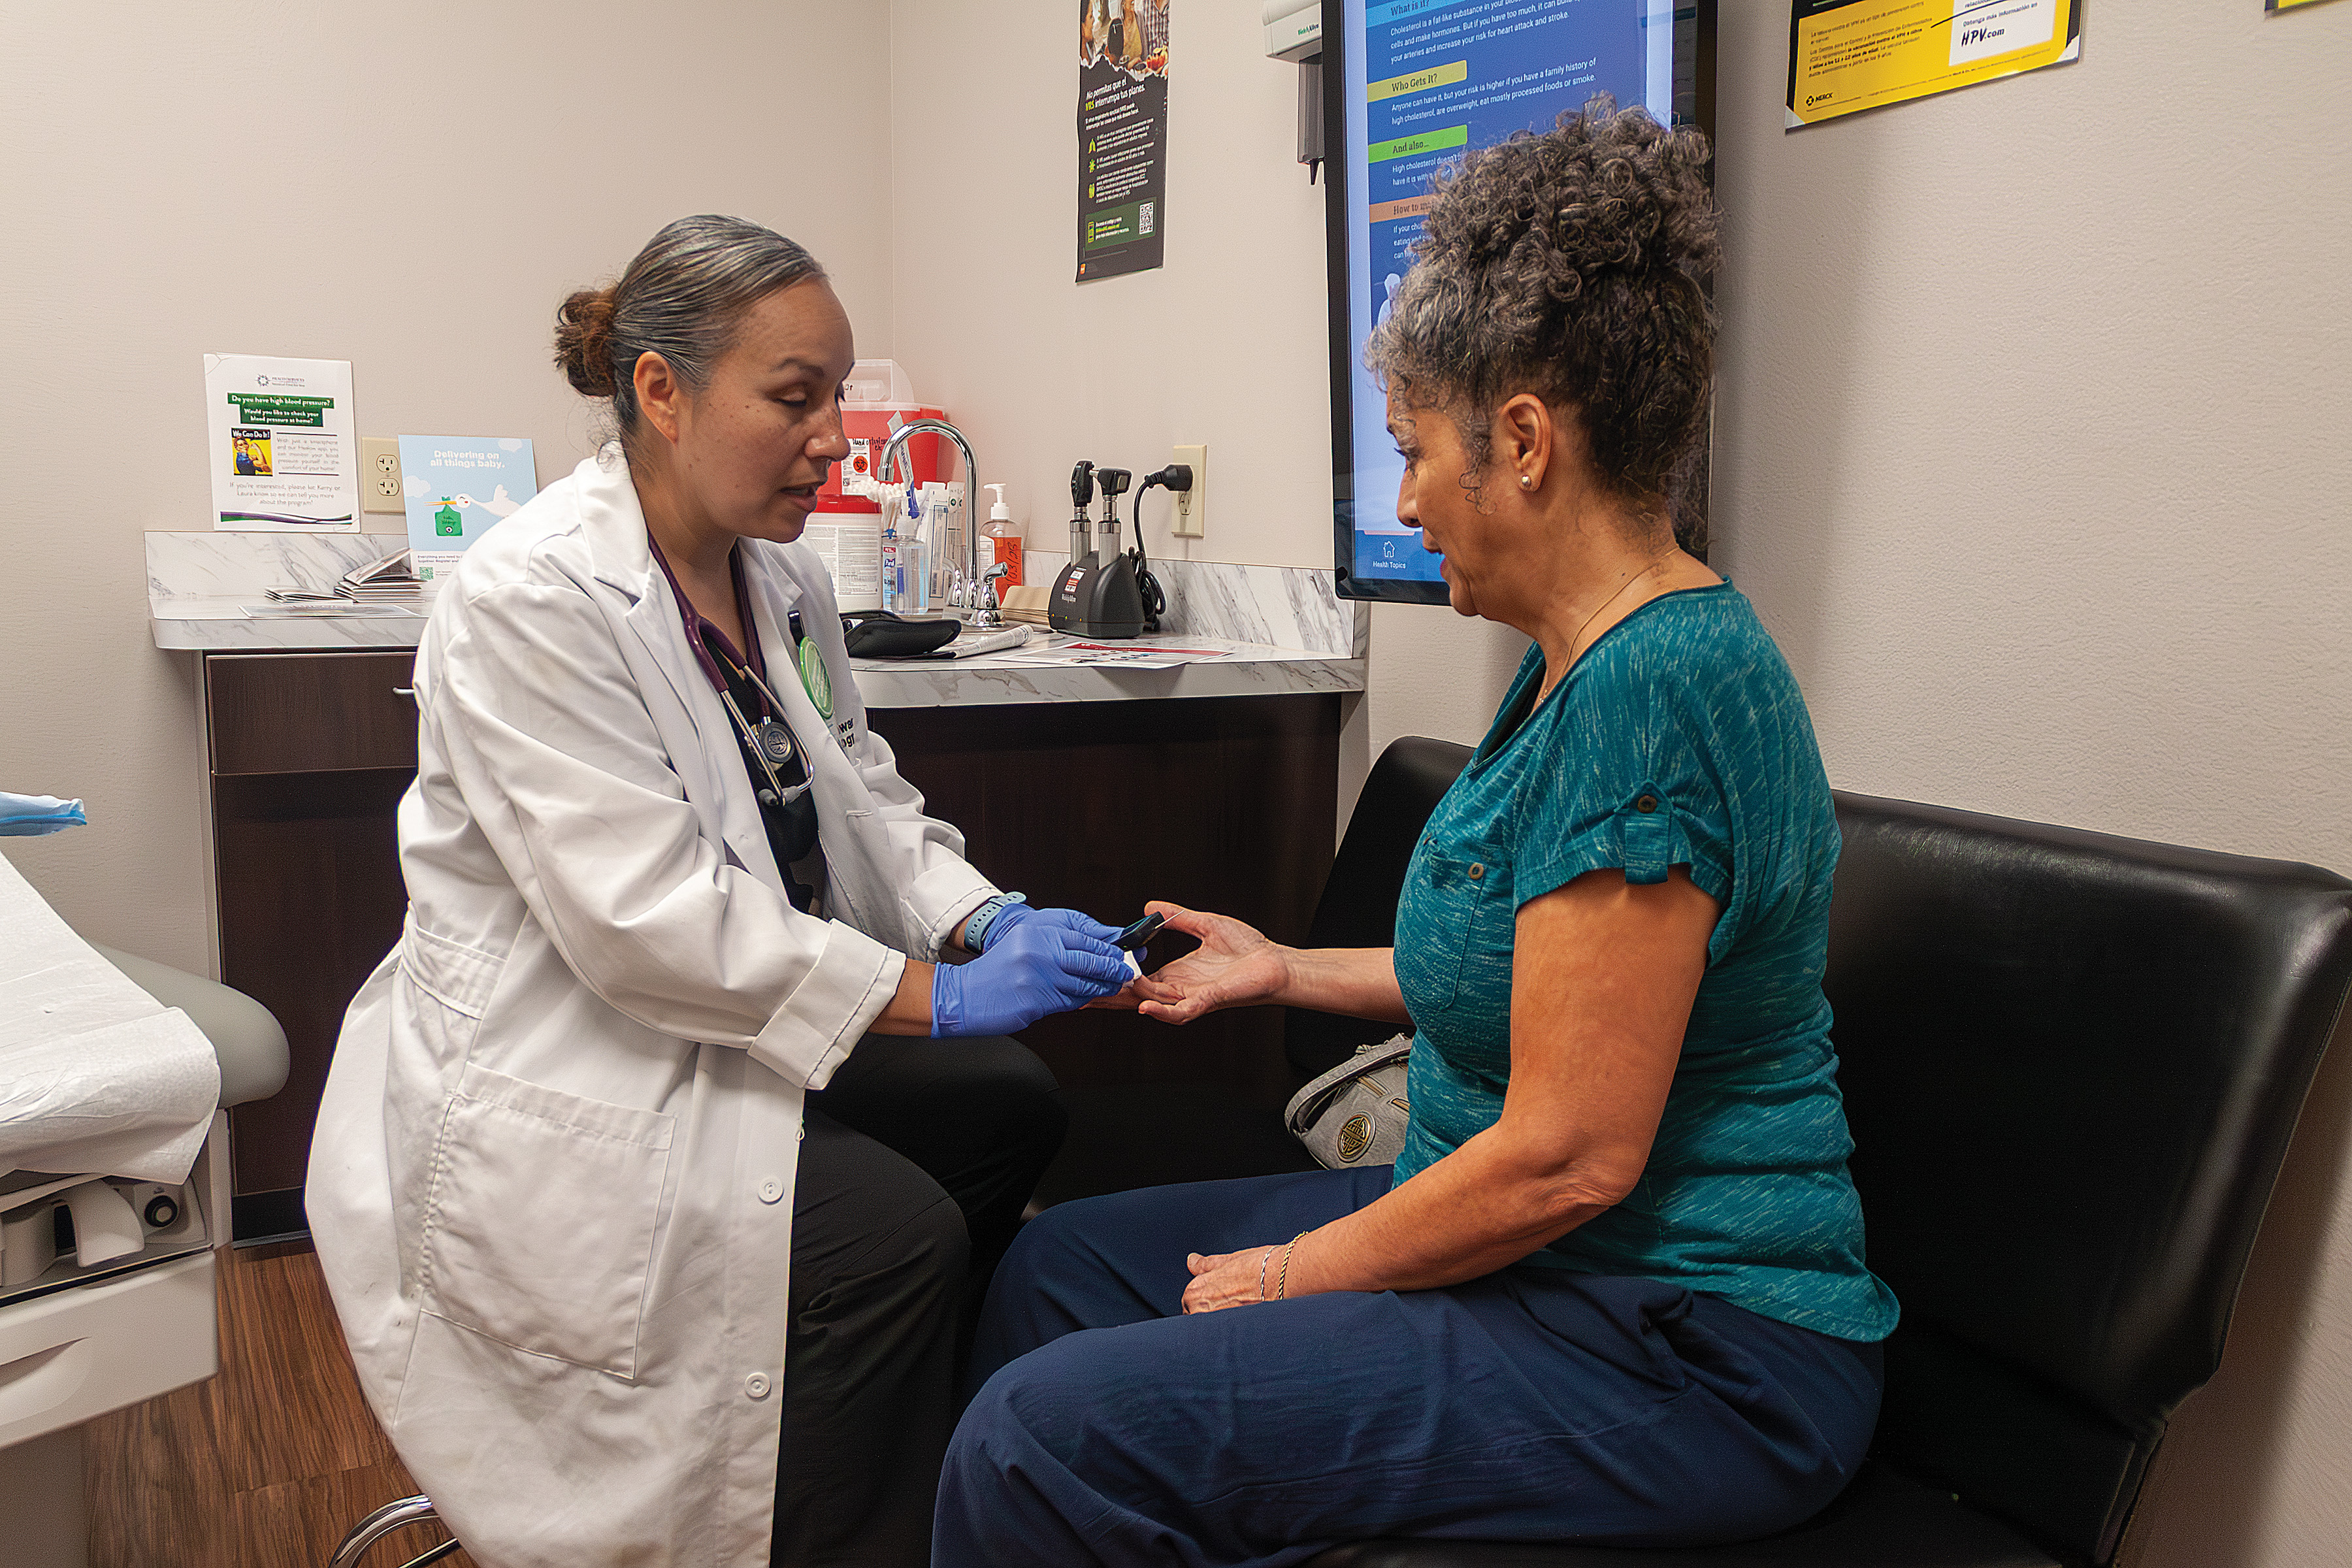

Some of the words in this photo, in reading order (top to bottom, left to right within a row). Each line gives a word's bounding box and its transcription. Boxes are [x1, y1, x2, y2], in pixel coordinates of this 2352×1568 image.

[1391, 3, 1410, 16] What
[1391, 20, 1421, 36] Cholesterol
[1453, 5, 1483, 19] substance
[1491, 0, 1503, 10] your
[1963, 17, 1985, 27] Obtenga
[1999, 4, 2030, 17] información
[1391, 40, 1403, 49] cells
[1404, 37, 1414, 46] and
[1416, 33, 1431, 43] make
[1432, 25, 1462, 38] hormones.
[1463, 22, 1473, 30] But
[1474, 18, 1478, 27] if
[1479, 17, 1490, 27] you
[1492, 14, 1506, 23] have
[1507, 10, 1517, 19] too
[1539, 2, 1543, 11] it
[1544, 0, 1556, 9] can
[1391, 54, 1403, 64] your
[1404, 48, 1424, 60] arteries
[1425, 44, 1436, 54] and
[1437, 39, 1461, 50] increase
[1462, 35, 1475, 46] your
[1476, 31, 1486, 41] risk
[1488, 29, 1497, 38] for
[1497, 25, 1513, 35] heart
[1514, 19, 1534, 31] attack
[1535, 15, 1547, 26] and
[1961, 27, 2005, 47] HPV.com
[1086, 90, 1093, 100] No
[1093, 84, 1112, 99] permitas
[1113, 80, 1121, 91] que
[1122, 76, 1126, 86] el
[1392, 81, 1409, 92] Who
[1410, 77, 1426, 88] Gets
[1428, 73, 1437, 84] It?
[1392, 101, 1412, 112] Anyone
[1413, 99, 1423, 107] can
[1424, 95, 1437, 105] have
[1444, 91, 1453, 100] but
[1454, 88, 1467, 98] your
[1468, 85, 1478, 94] risk
[1486, 79, 1505, 91] higher
[1506, 76, 1511, 86] if
[1511, 76, 1523, 87] you
[1524, 72, 1539, 82] have
[1545, 65, 1565, 77] family
[1565, 60, 1588, 73] history
[1589, 57, 1597, 66] of
[1085, 100, 1095, 111] VRS
[1095, 92, 1120, 108] interrumpa
[1120, 90, 1128, 99] tus
[1128, 84, 1145, 98] planes.
[1392, 116, 1404, 126] high
[1436, 107, 1445, 116] are
[1480, 97, 1490, 106] eat
[1491, 91, 1511, 104] mostly
[1512, 84, 1544, 101] processed
[1544, 80, 1563, 91] foods
[1564, 78, 1571, 88] or
[1572, 73, 1596, 86] smoke.
[1815, 92, 1833, 103] MERCK
[1392, 142, 1407, 154] And
[1392, 163, 1405, 174] High
[1406, 157, 1436, 171] cholesterol
[1392, 178, 1405, 186] have
[1394, 204, 1410, 215] How
[1412, 203, 1418, 212] to
[1394, 225, 1398, 233] If
[1399, 225, 1410, 235] your
[1394, 238, 1411, 246] eating
[270, 397, 284, 405] high
[434, 450, 485, 460] Delivering
[445, 458, 476, 468] things
[478, 459, 506, 470] baby.
